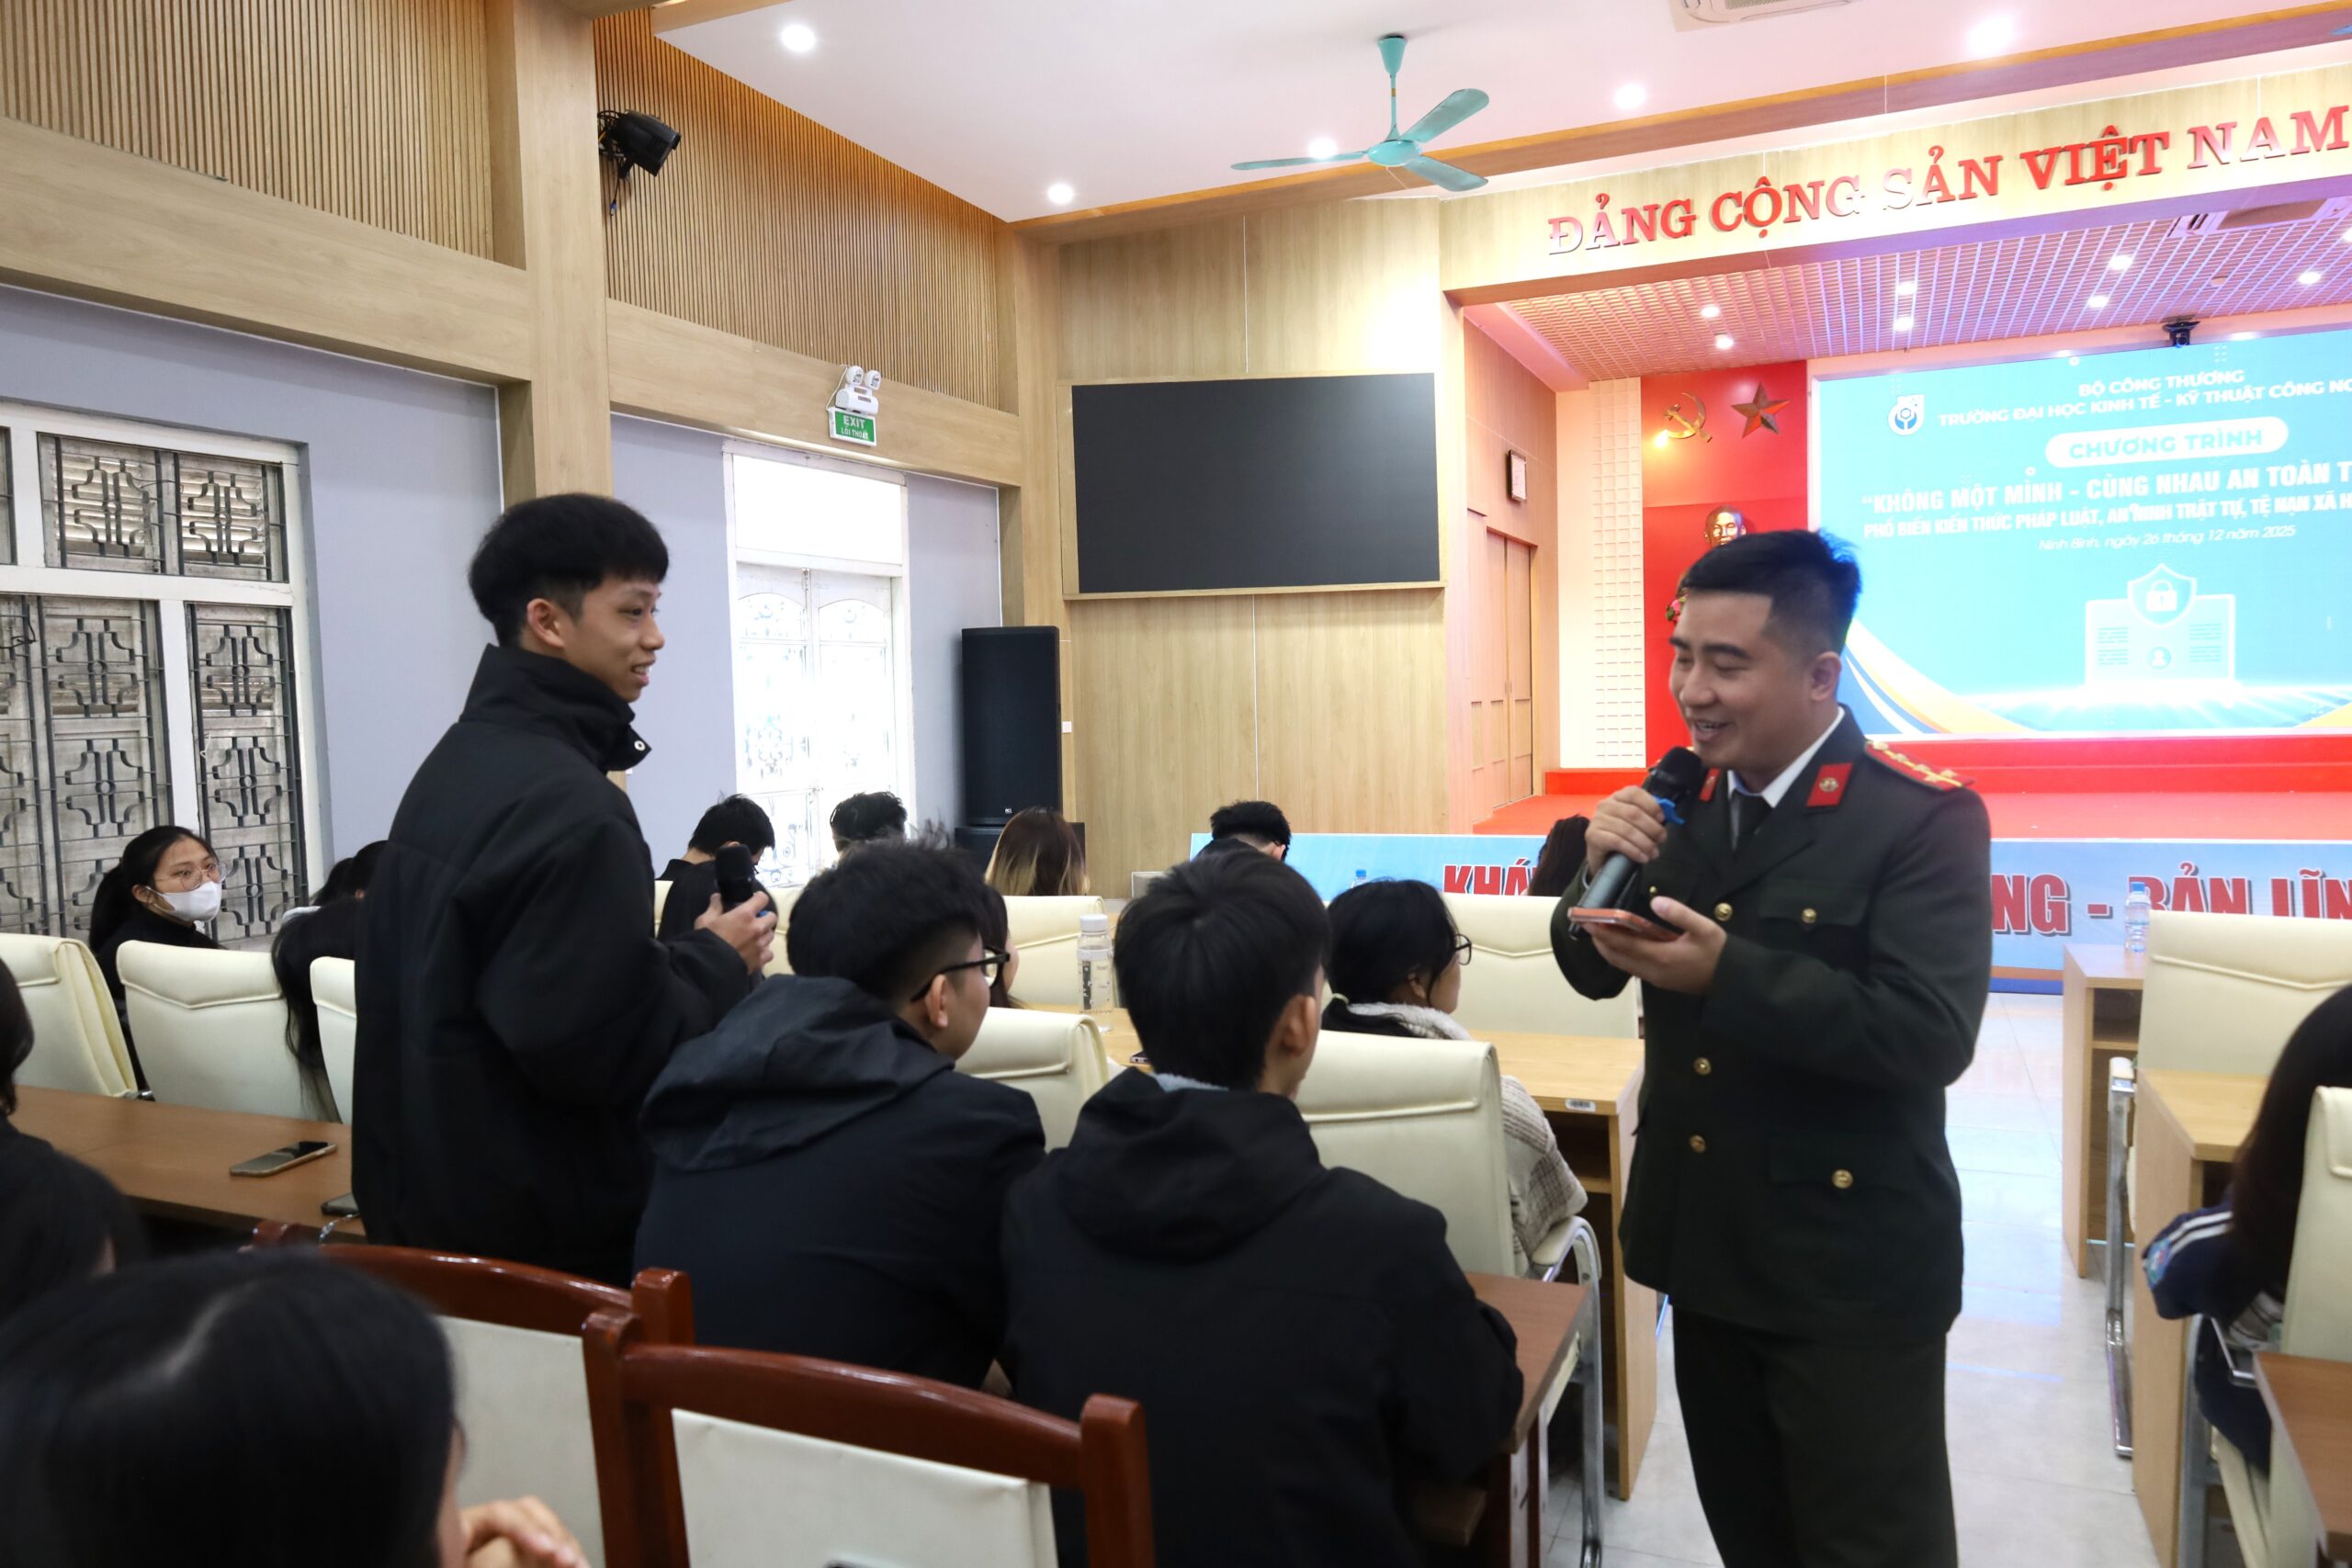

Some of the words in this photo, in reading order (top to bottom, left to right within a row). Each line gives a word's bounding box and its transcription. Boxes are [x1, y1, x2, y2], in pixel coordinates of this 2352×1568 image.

[1548, 192, 1697, 254] ĐẢNG
[1711, 175, 1865, 238] CỘNG
[1883, 145, 2003, 209] SẢN
[2021, 124, 2170, 191] VIỆT
[2187, 105, 2350, 169] NAM
[2078, 380, 2106, 398] BỘ
[2109, 377, 2161, 394] CÔNG
[2165, 369, 2245, 389] THƯƠNG
[843, 415, 865, 429] EXIT
[1939, 407, 2009, 426] TRƯỜNG
[2013, 405, 2044, 423] ĐẠI
[2048, 401, 2086, 418] HỌC
[2090, 399, 2134, 413] KINH
[2138, 391, 2161, 410] TẾ
[2176, 389, 2199, 407] KỸ
[2205, 385, 2266, 403] THUẬT
[2268, 381, 2324, 398] CÔNG
[2069, 436, 2177, 459] CHƯƠNG
[2184, 427, 2263, 451] TRÌNH
[1951, 483, 1997, 511] MỘT
[2004, 479, 2063, 505] MÌNH
[2086, 473, 2149, 499] CÙNG
[2155, 470, 2220, 495] NHAU
[2226, 468, 2259, 491] AN
[2266, 459, 2331, 487] TOÀN
[1897, 515, 1930, 537] BIẾN
[1935, 513, 1968, 534] KIẾN
[1972, 512, 2012, 532] THỨC
[2015, 509, 2057, 529] PHÁP
[2176, 498, 2218, 521] TRẬT
[2250, 494, 2271, 517] TỆ
[2274, 495, 2309, 516] NẠN
[2039, 539, 2067, 550] Ninh
[2104, 532, 2139, 548] ngày
[2143, 533, 2159, 545] 26
[2162, 529, 2203, 545] tháng
[2209, 529, 2223, 541] 12
[2225, 527, 2260, 540] năm
[2262, 525, 2296, 538] 2025
[1443, 858, 1537, 896] KHÁ
